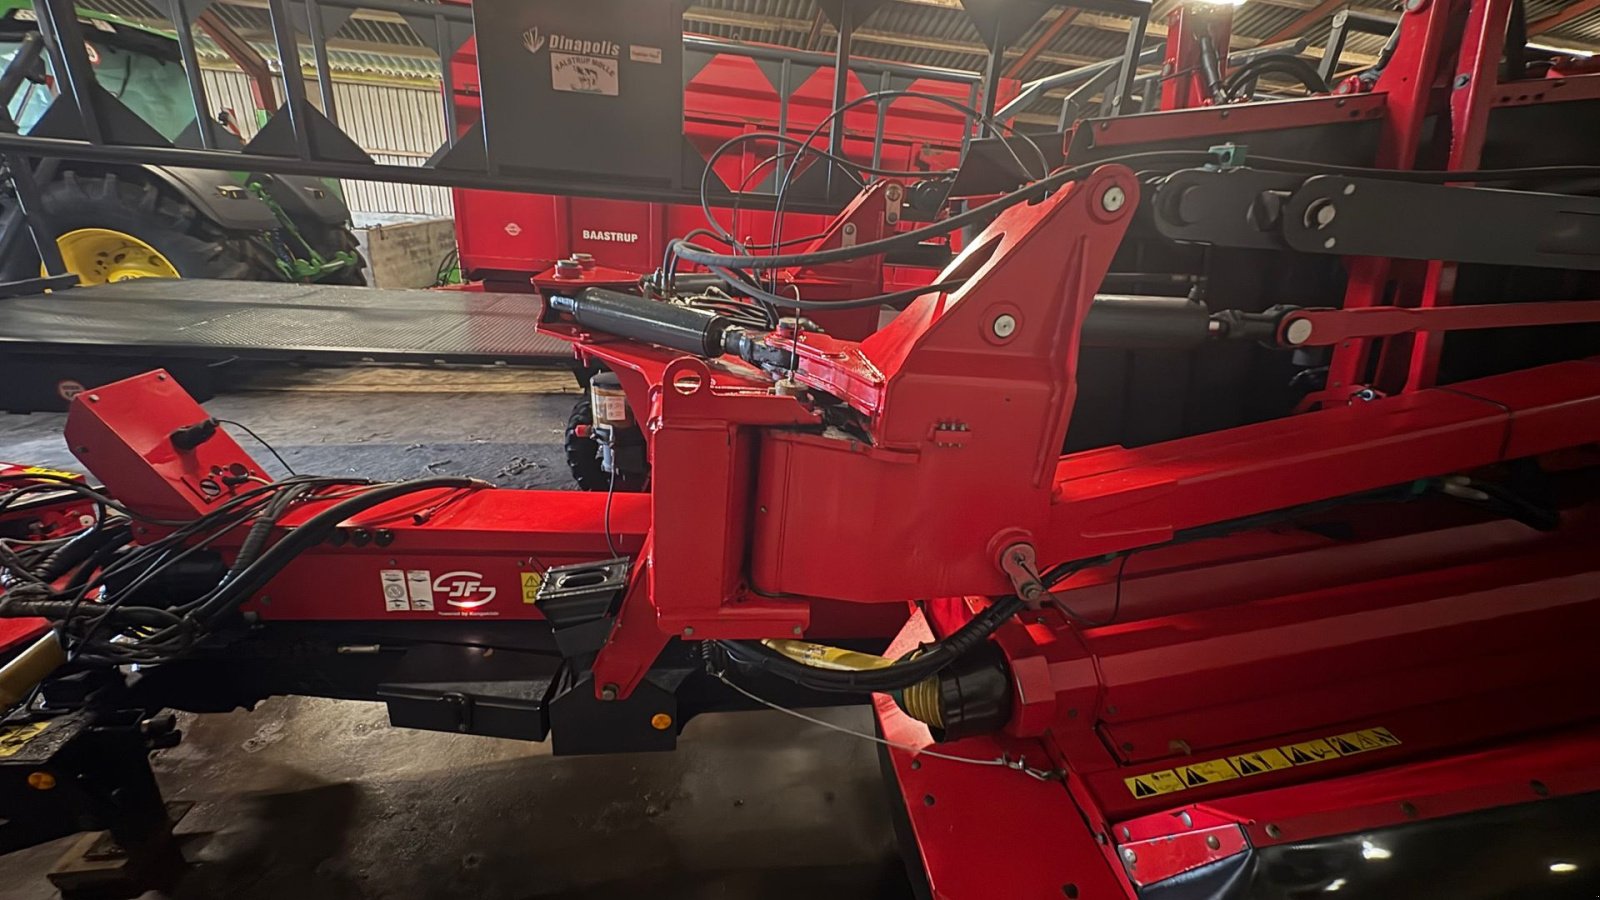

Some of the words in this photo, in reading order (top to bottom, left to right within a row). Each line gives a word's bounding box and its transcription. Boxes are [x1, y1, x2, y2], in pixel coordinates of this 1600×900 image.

[549, 34, 620, 56] Dinapolis
[582, 229, 638, 243] BAASTRUP
[449, 581, 480, 596] JF
